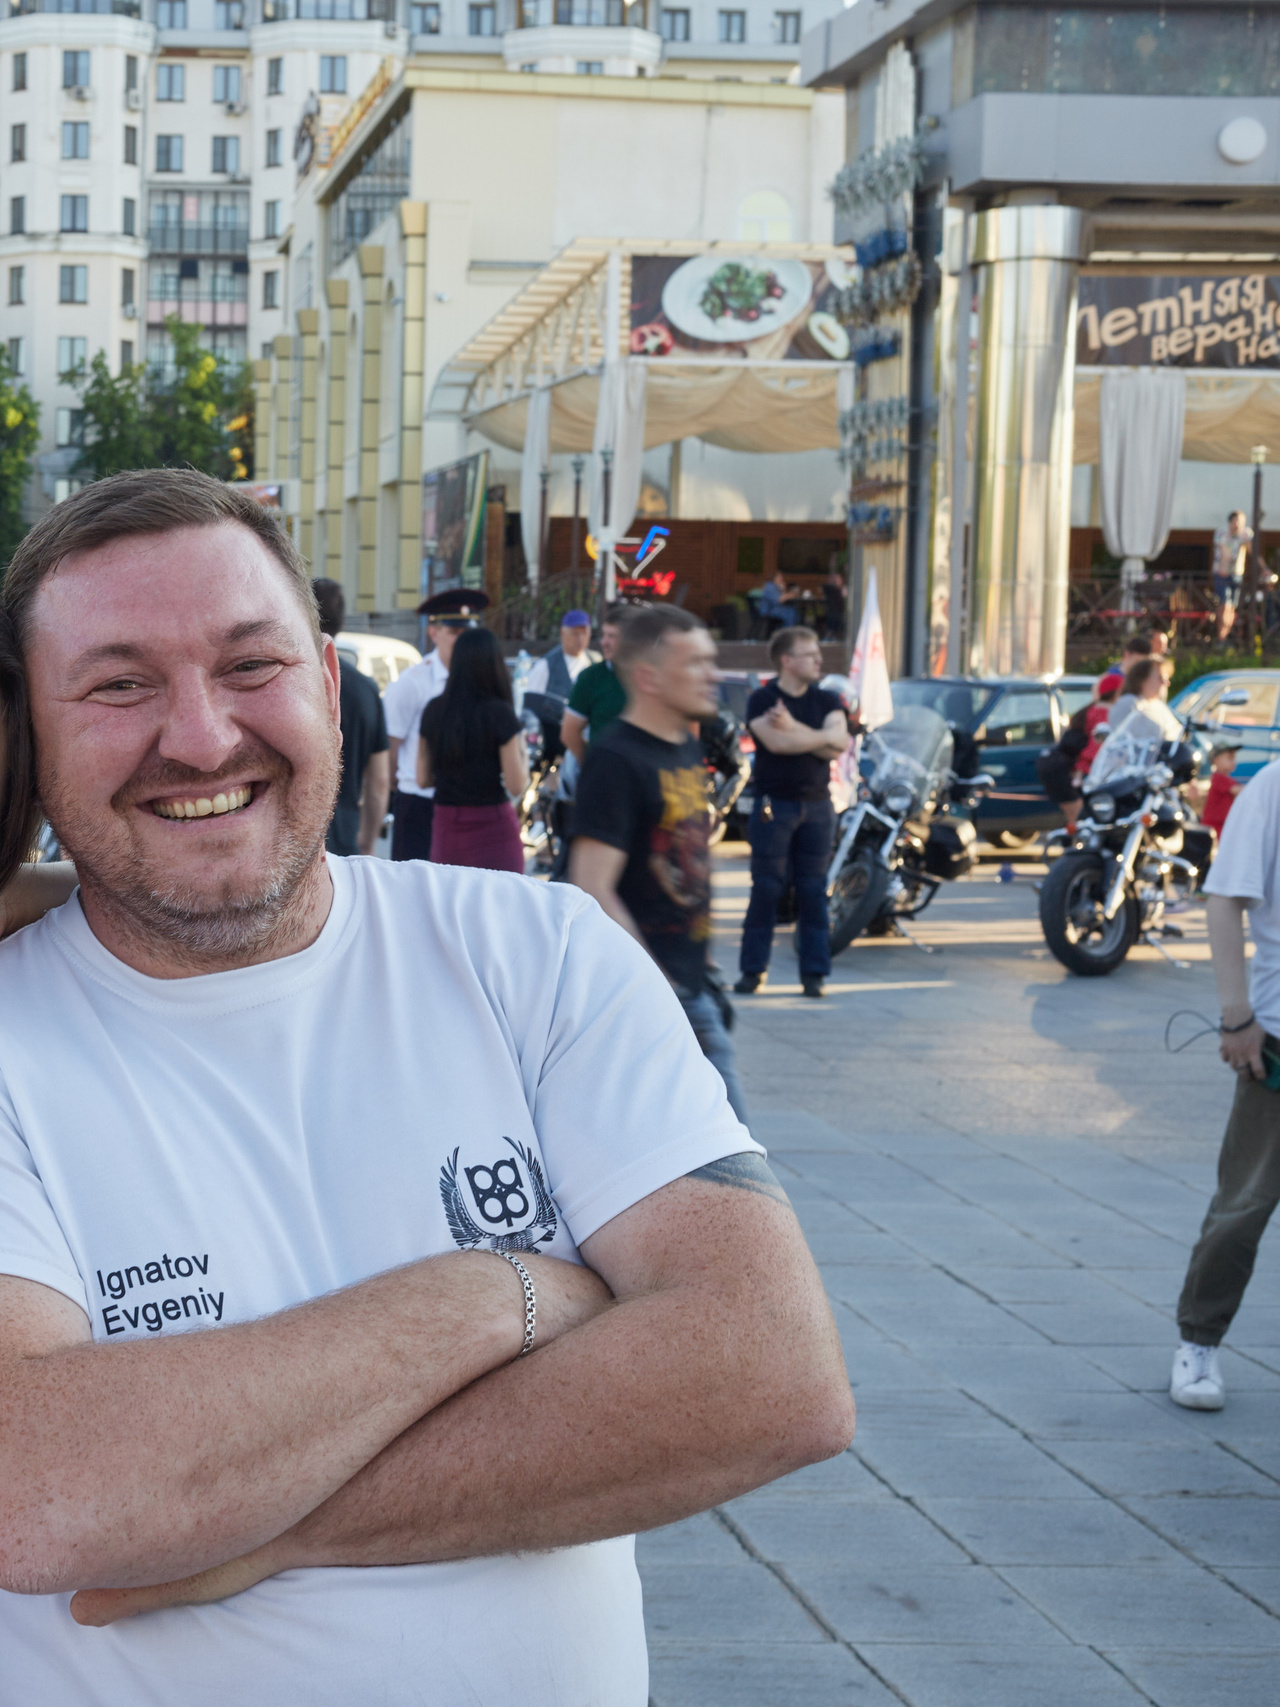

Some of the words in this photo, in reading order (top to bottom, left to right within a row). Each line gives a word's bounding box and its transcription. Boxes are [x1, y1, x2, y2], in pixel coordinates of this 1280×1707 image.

[1151, 301, 1280, 362] веран
[96, 1253, 209, 1300] Ignatov
[101, 1287, 224, 1336] Evgeniy
